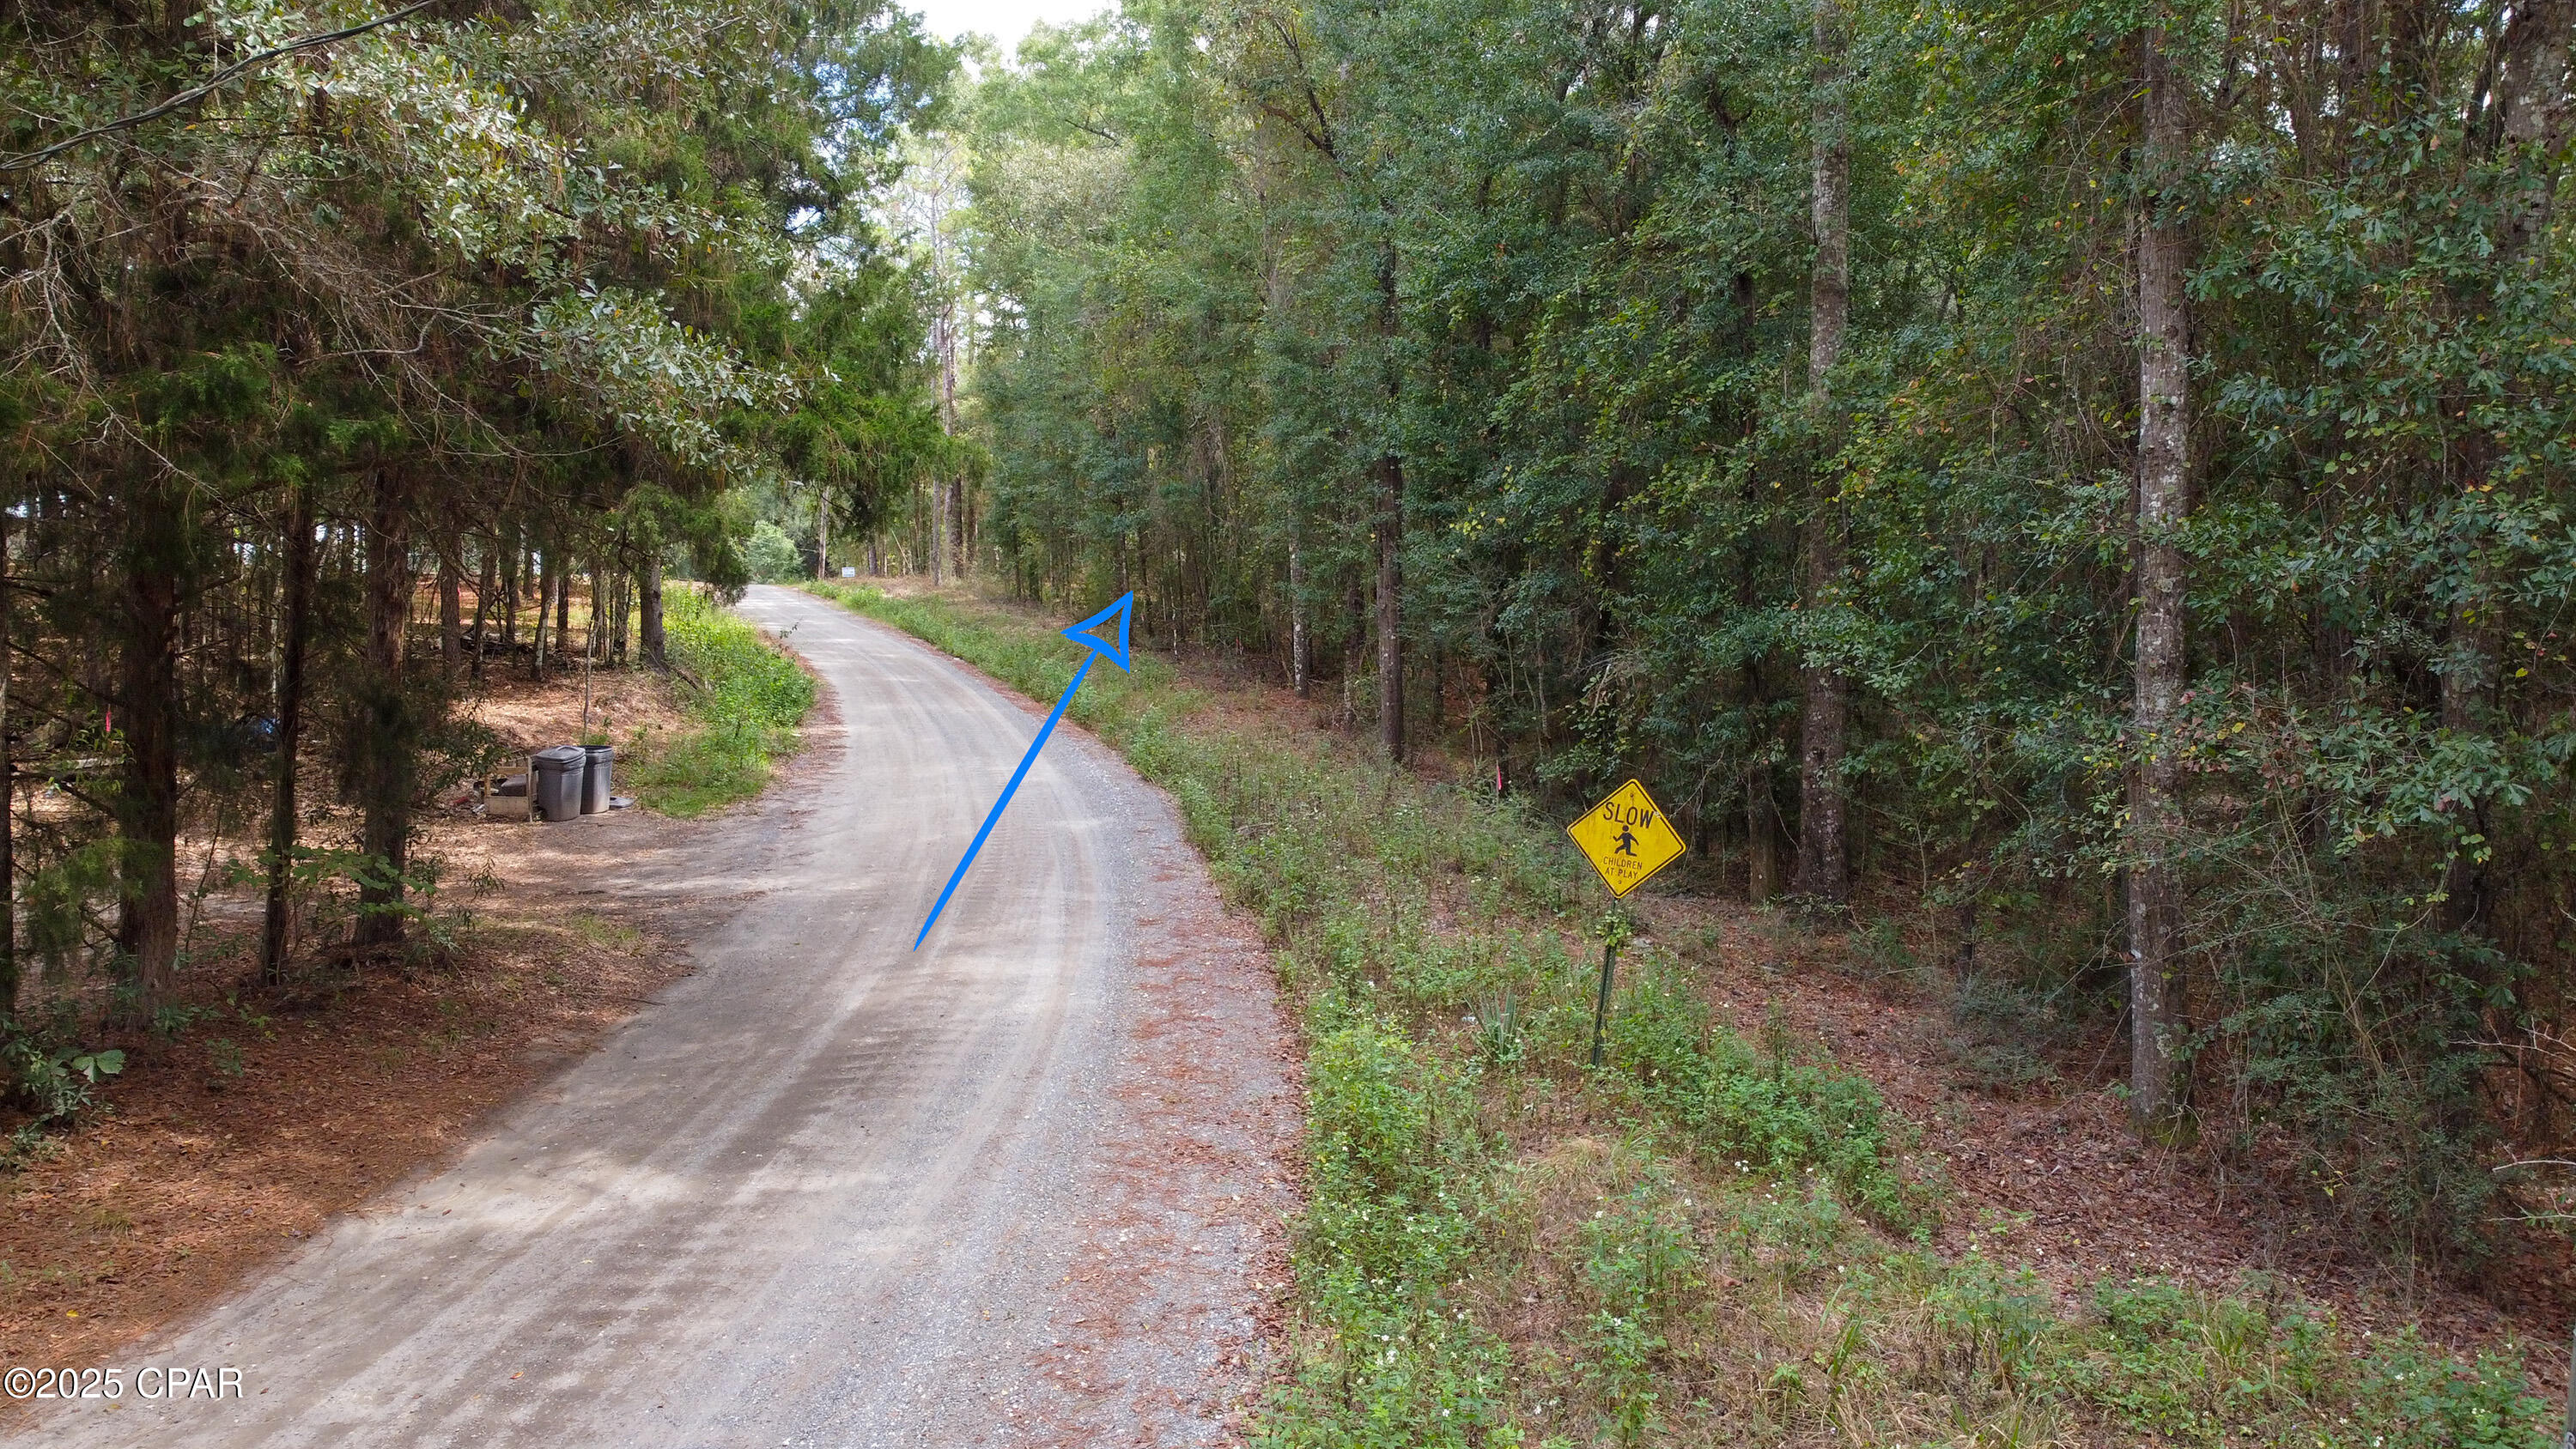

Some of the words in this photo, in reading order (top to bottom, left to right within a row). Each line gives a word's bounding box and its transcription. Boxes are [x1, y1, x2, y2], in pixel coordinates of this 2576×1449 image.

[1603, 802, 1655, 829] SLOW
[1603, 857, 1643, 870] CHILDREN
[1605, 867, 1615, 876] AT
[1618, 870, 1638, 879] PLAY
